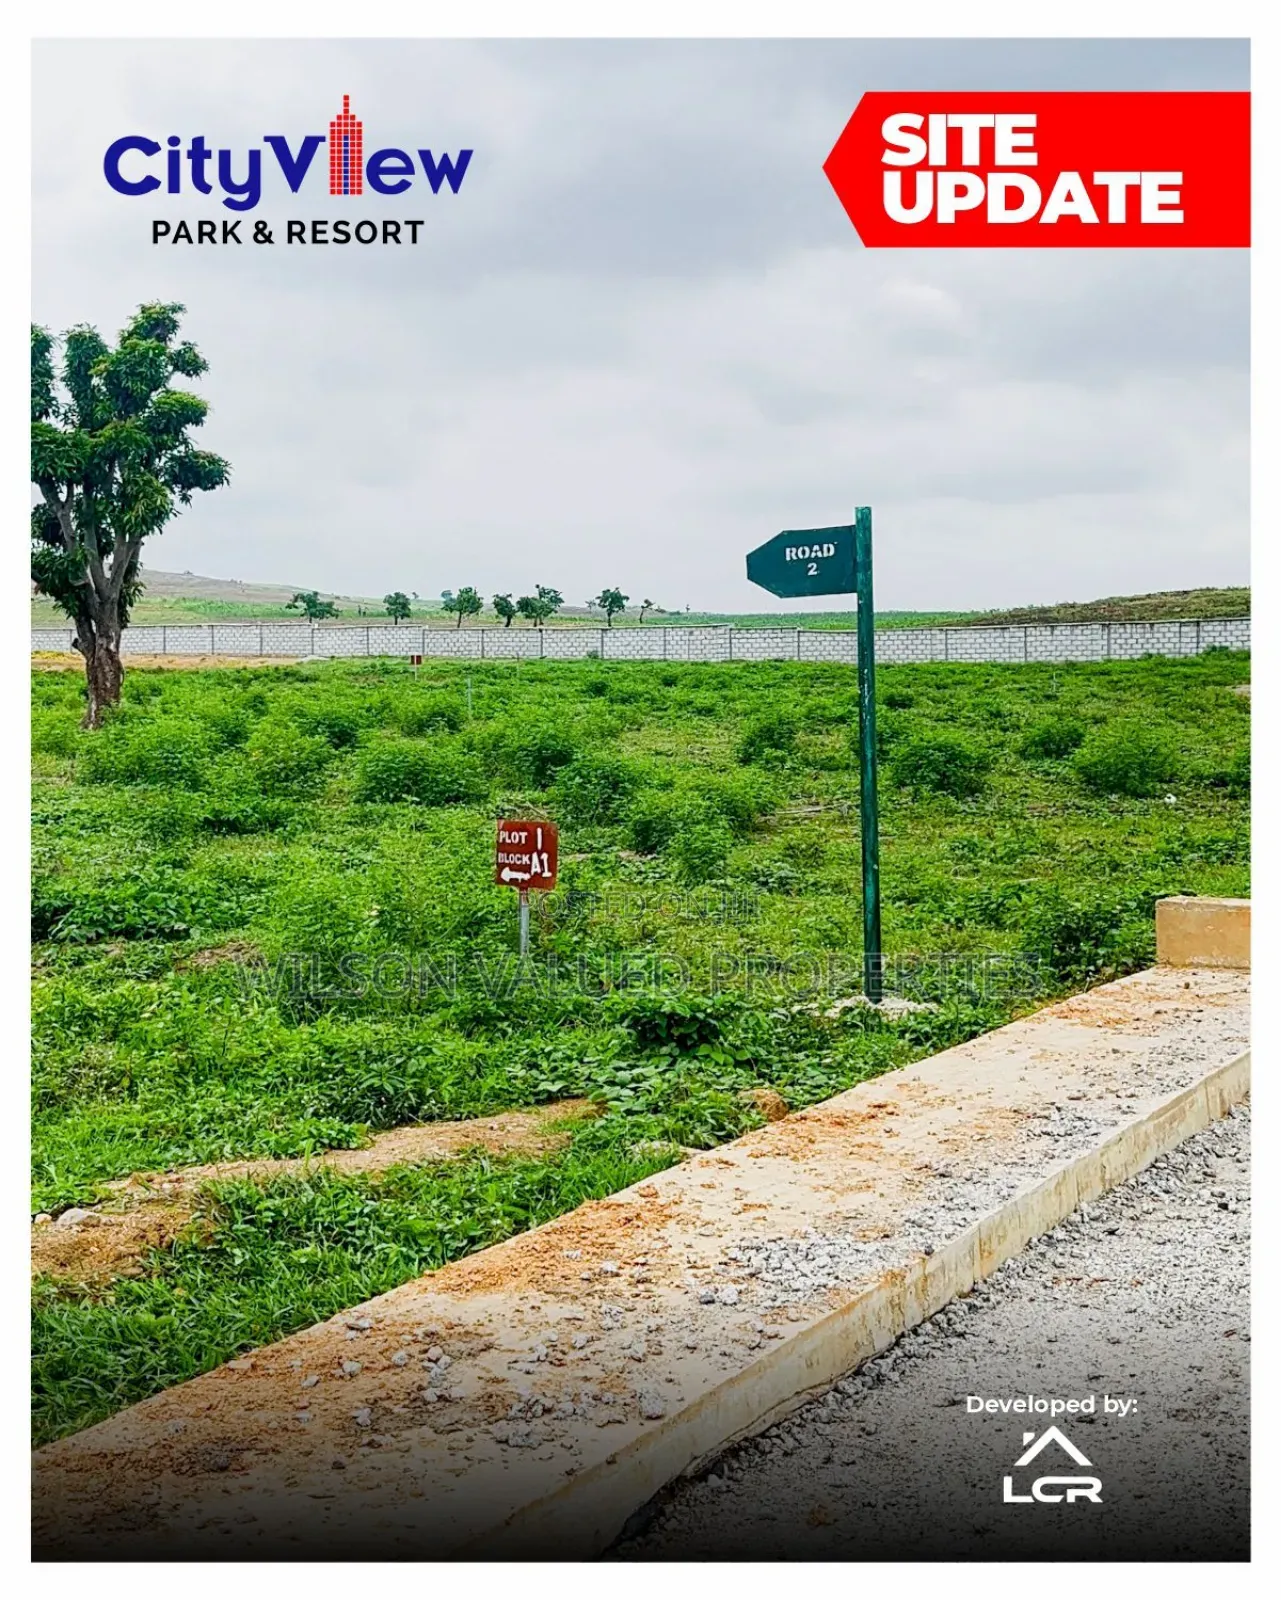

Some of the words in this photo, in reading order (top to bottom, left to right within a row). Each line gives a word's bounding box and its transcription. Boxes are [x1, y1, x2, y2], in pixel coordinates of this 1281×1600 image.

[785, 543, 835, 561] ROAD
[807, 563, 818, 576] 2
[499, 830, 528, 845] PLOT
[498, 852, 530, 865] BLOCK
[531, 851, 553, 878] A1
